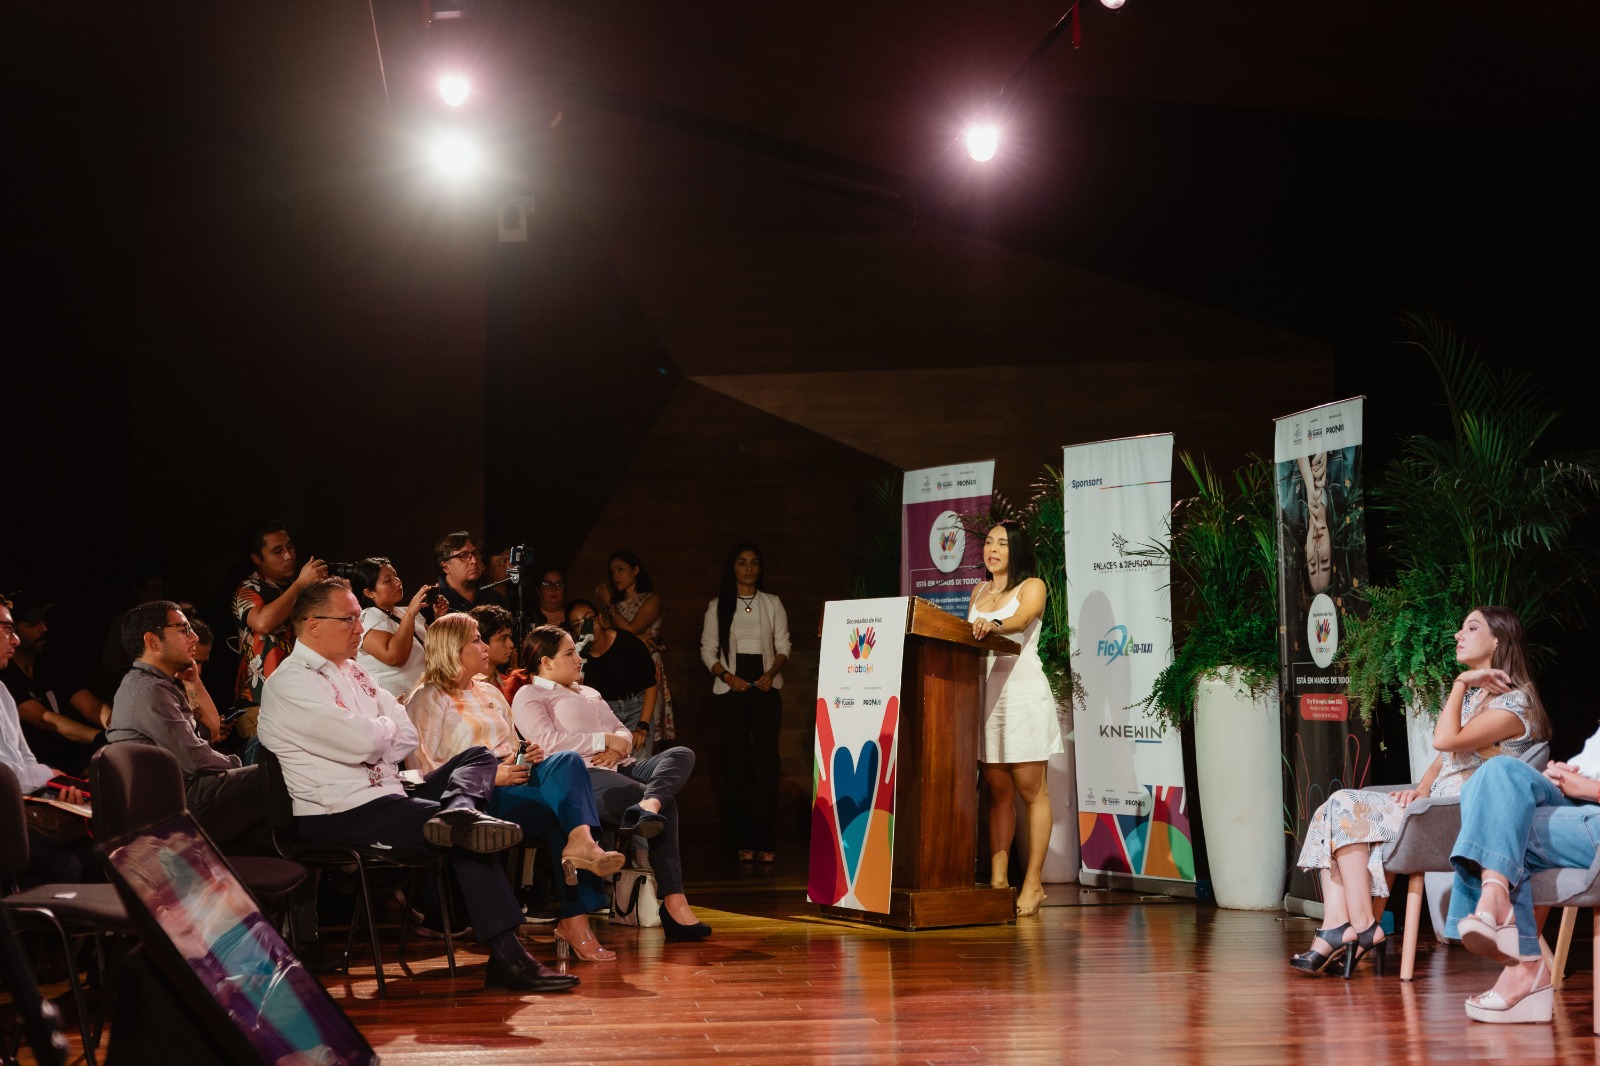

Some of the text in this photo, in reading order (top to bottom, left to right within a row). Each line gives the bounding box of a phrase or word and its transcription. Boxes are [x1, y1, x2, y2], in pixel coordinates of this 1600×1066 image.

[1072, 478, 1102, 490] Sponsors
[1094, 562, 1117, 570] ENLACES
[916, 580, 926, 588] ESTÁ
[1296, 675, 1306, 684] ESTÁ
[1100, 724, 1162, 738] KNEWIN
